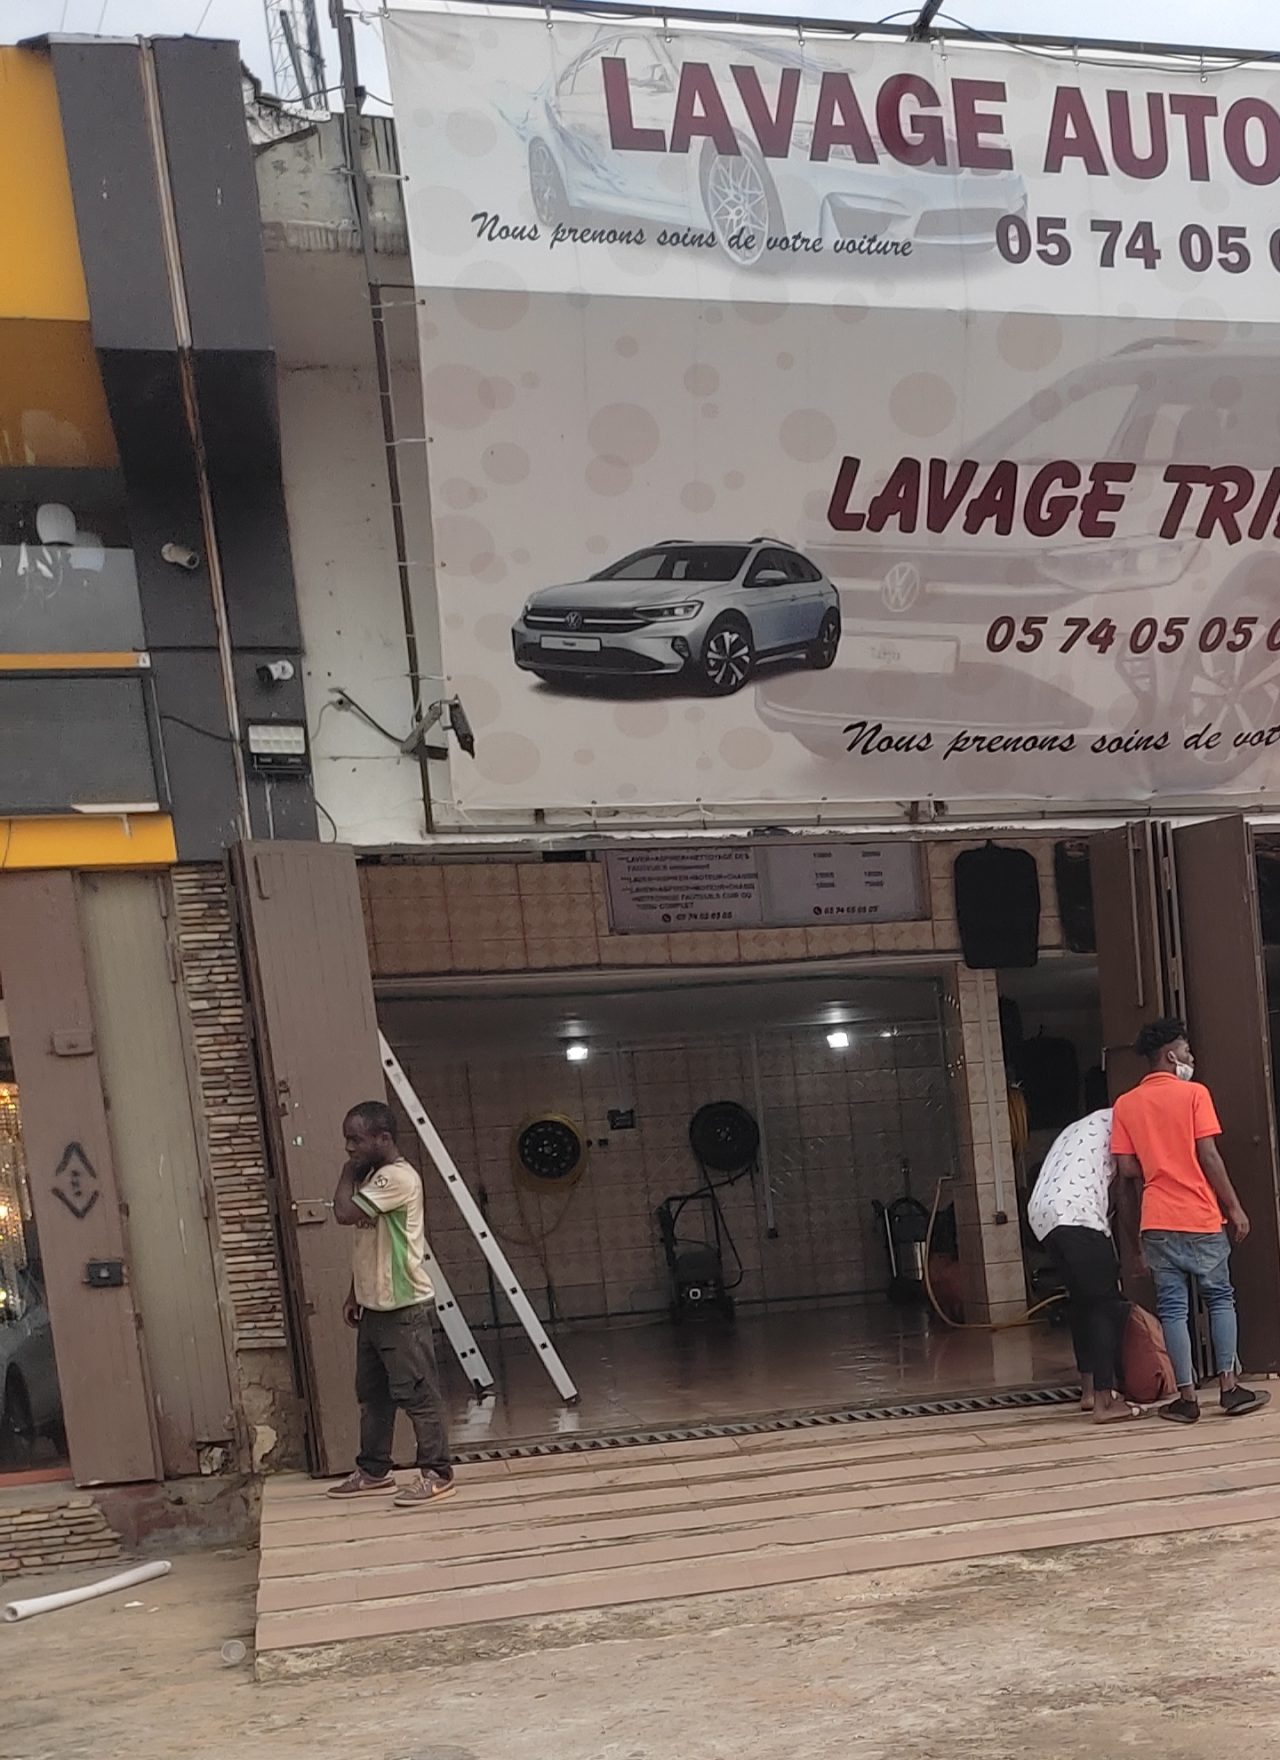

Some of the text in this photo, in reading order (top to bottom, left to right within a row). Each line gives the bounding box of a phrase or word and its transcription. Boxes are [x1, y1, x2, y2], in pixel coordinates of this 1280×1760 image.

[601, 56, 1014, 171] LAVAGE
[471, 211, 914, 257] Nous prenons soins de votre voiture
[995, 215, 1072, 267] 05
[1090, 219, 1161, 271] 74
[1178, 222, 1250, 275] 05
[827, 456, 1136, 539] LAVAGE
[985, 616, 1049, 652] 05
[1058, 617, 1116, 654] 74
[1129, 617, 1189, 654] 05
[1197, 617, 1259, 654] 05
[842, 721, 934, 757] Nous
[944, 727, 1077, 760] prenons
[1091, 724, 1171, 753] soins
[1182, 722, 1222, 752] de
